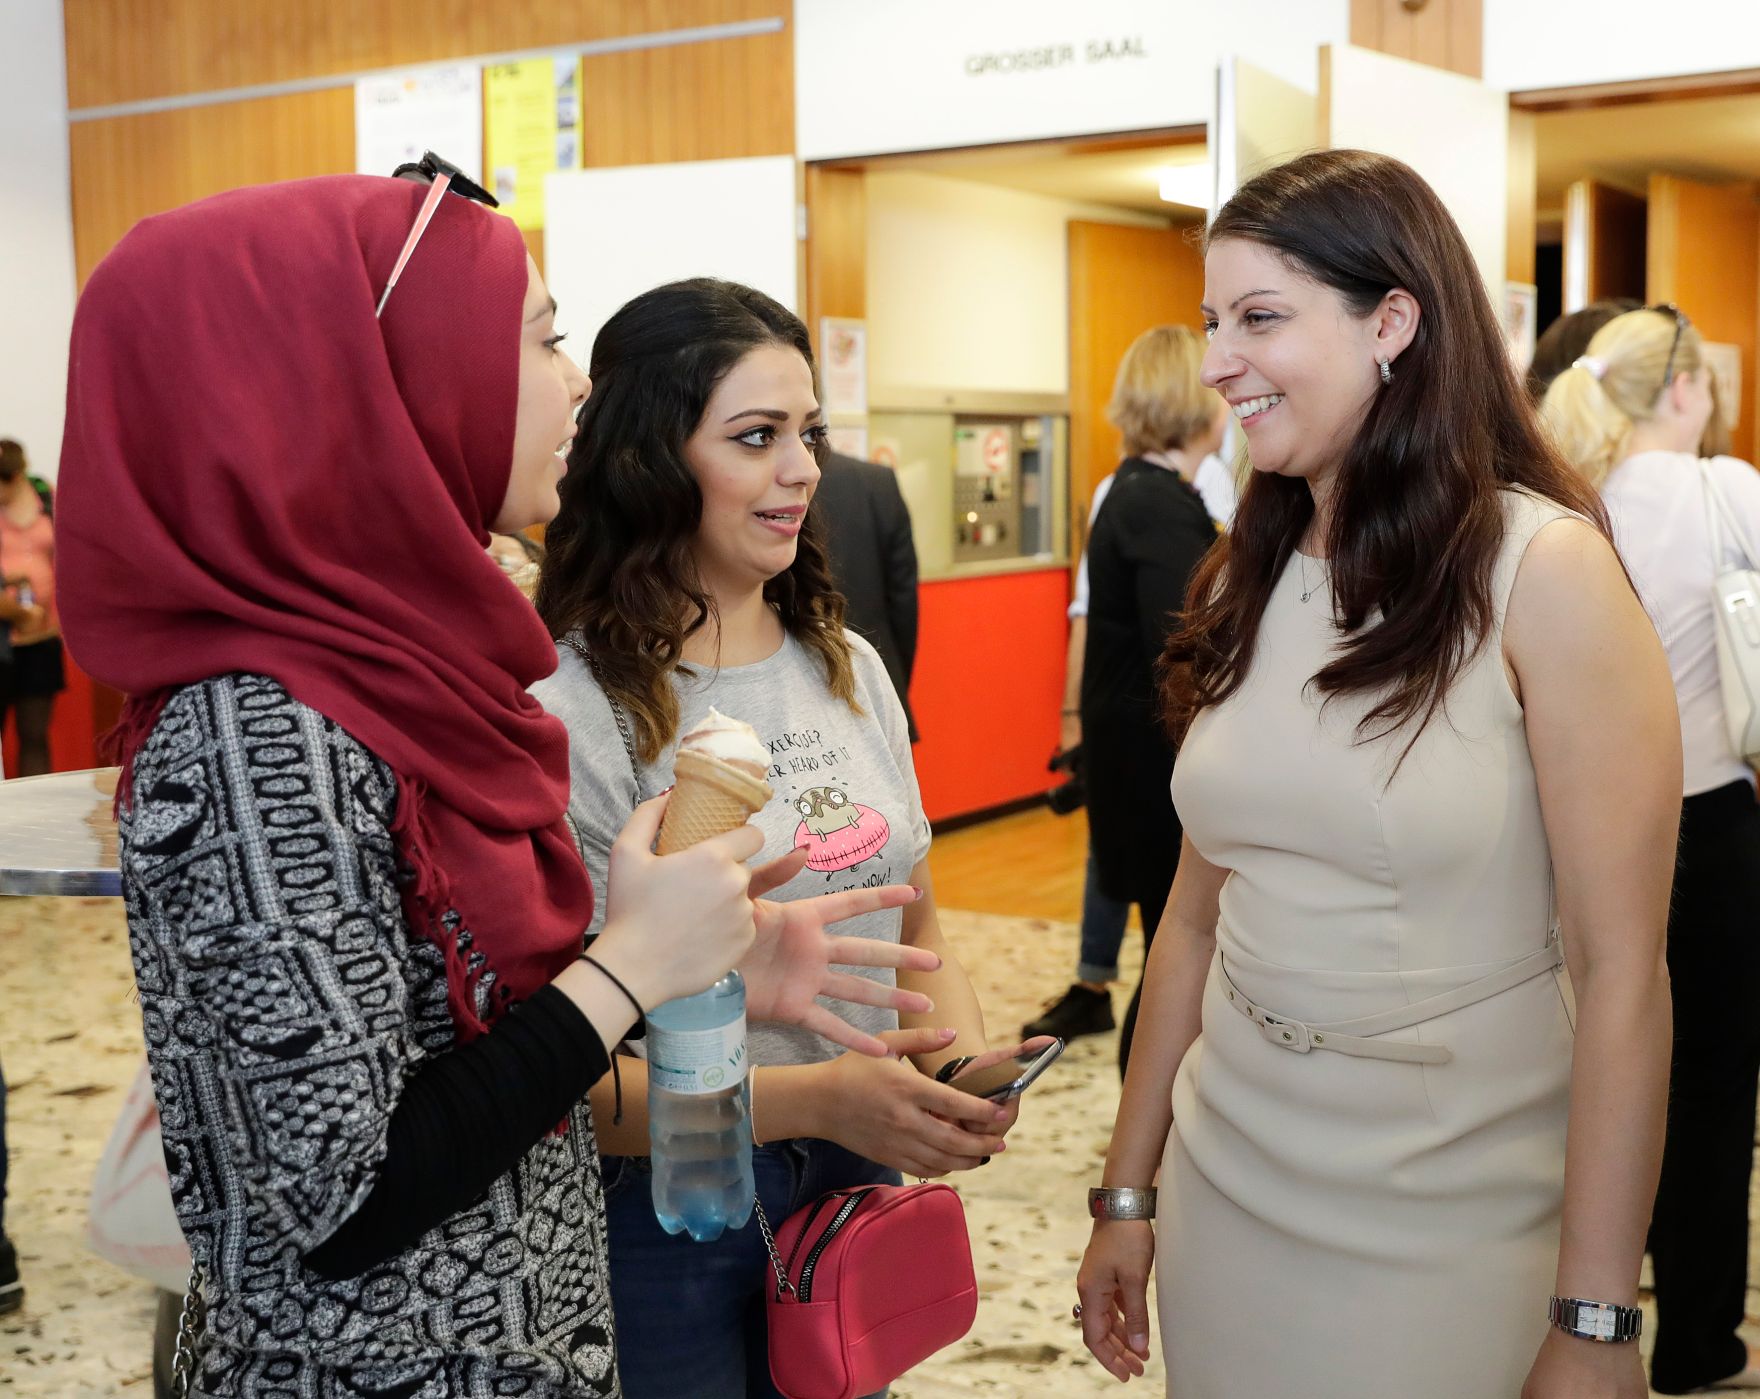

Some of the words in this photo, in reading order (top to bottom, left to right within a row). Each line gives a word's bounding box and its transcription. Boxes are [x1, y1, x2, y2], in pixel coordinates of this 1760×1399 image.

[965, 43, 1075, 77] GROSSER
[1086, 34, 1149, 64] SAAL
[763, 729, 823, 755] XERCISE?
[788, 756, 820, 774] HEARD
[822, 750, 839, 766] OF
[862, 866, 891, 888] NOW!
